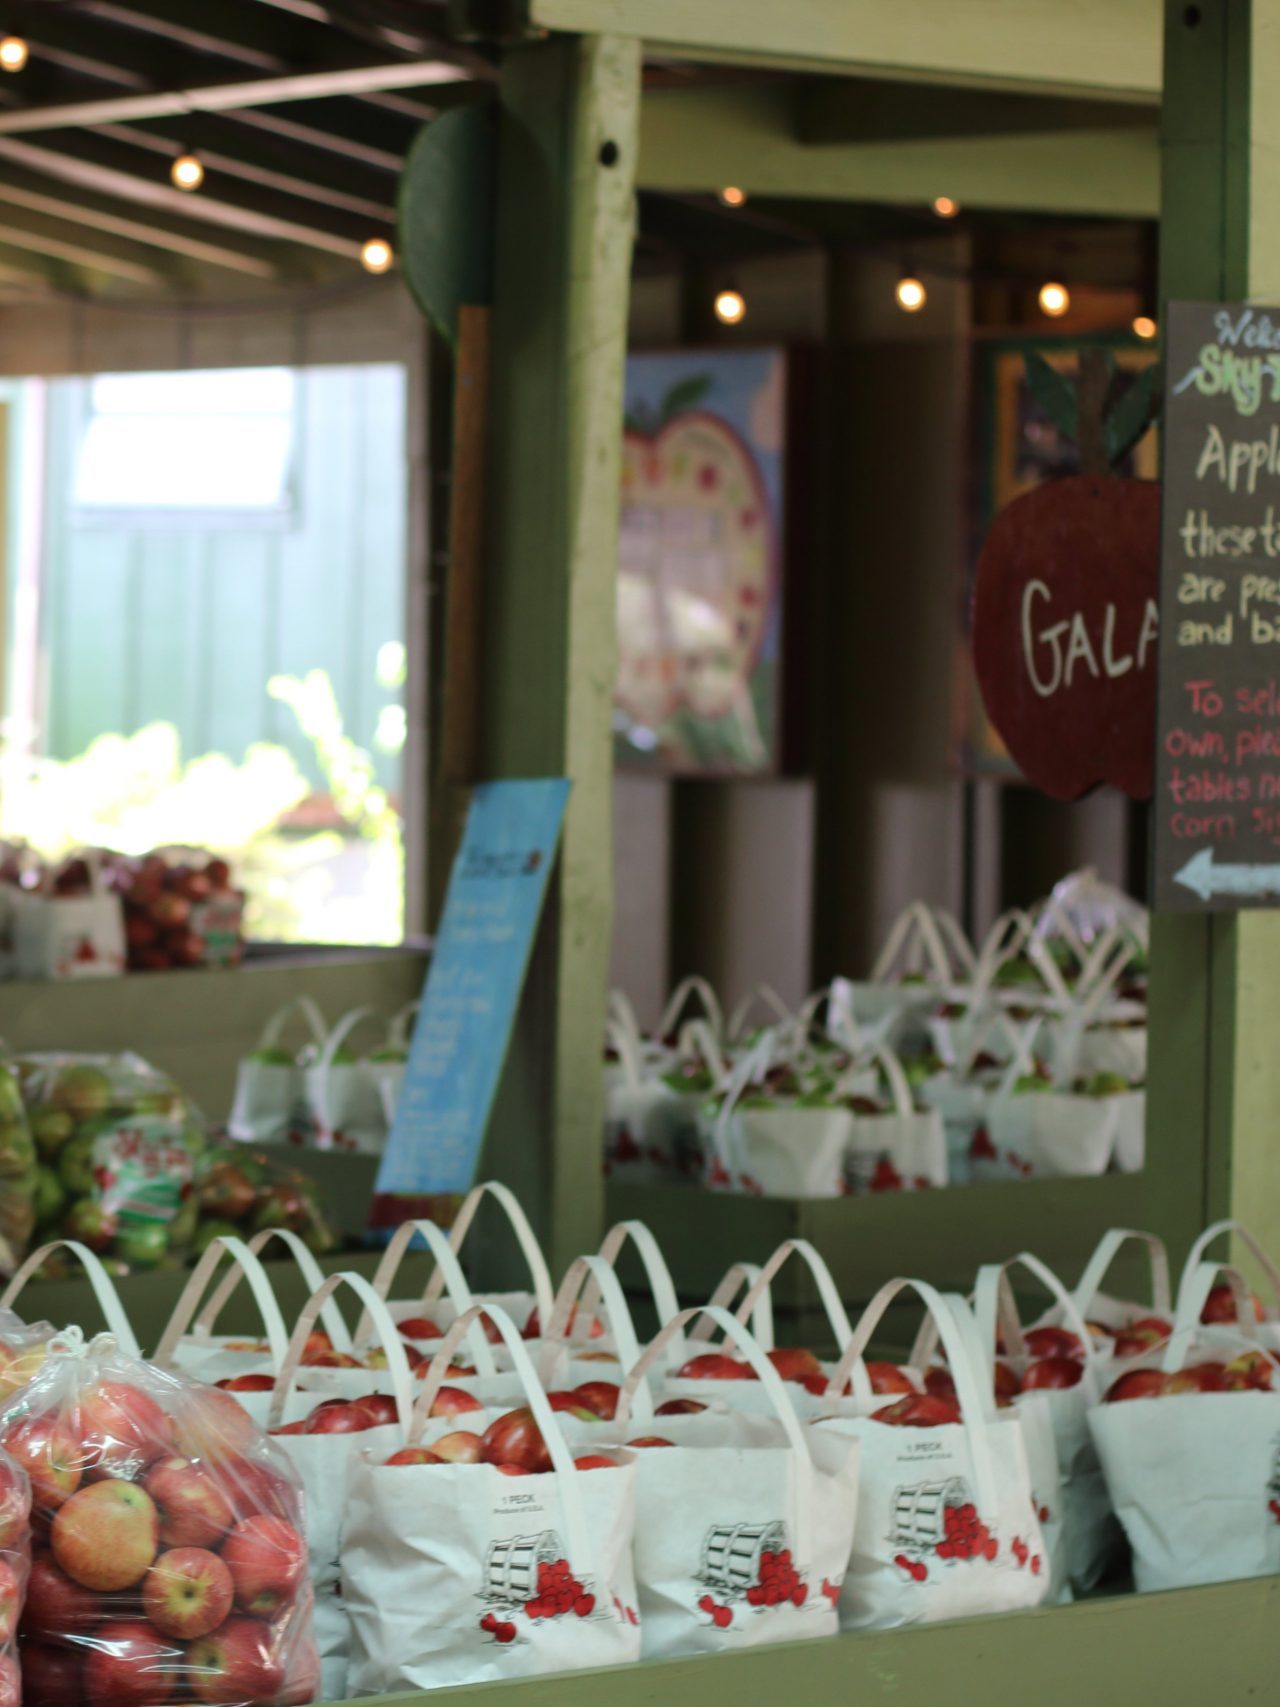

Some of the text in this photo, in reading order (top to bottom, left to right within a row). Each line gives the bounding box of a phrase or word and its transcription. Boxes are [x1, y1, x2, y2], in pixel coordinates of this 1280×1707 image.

[1177, 572, 1280, 620] are pre
[1177, 611, 1234, 646] and
